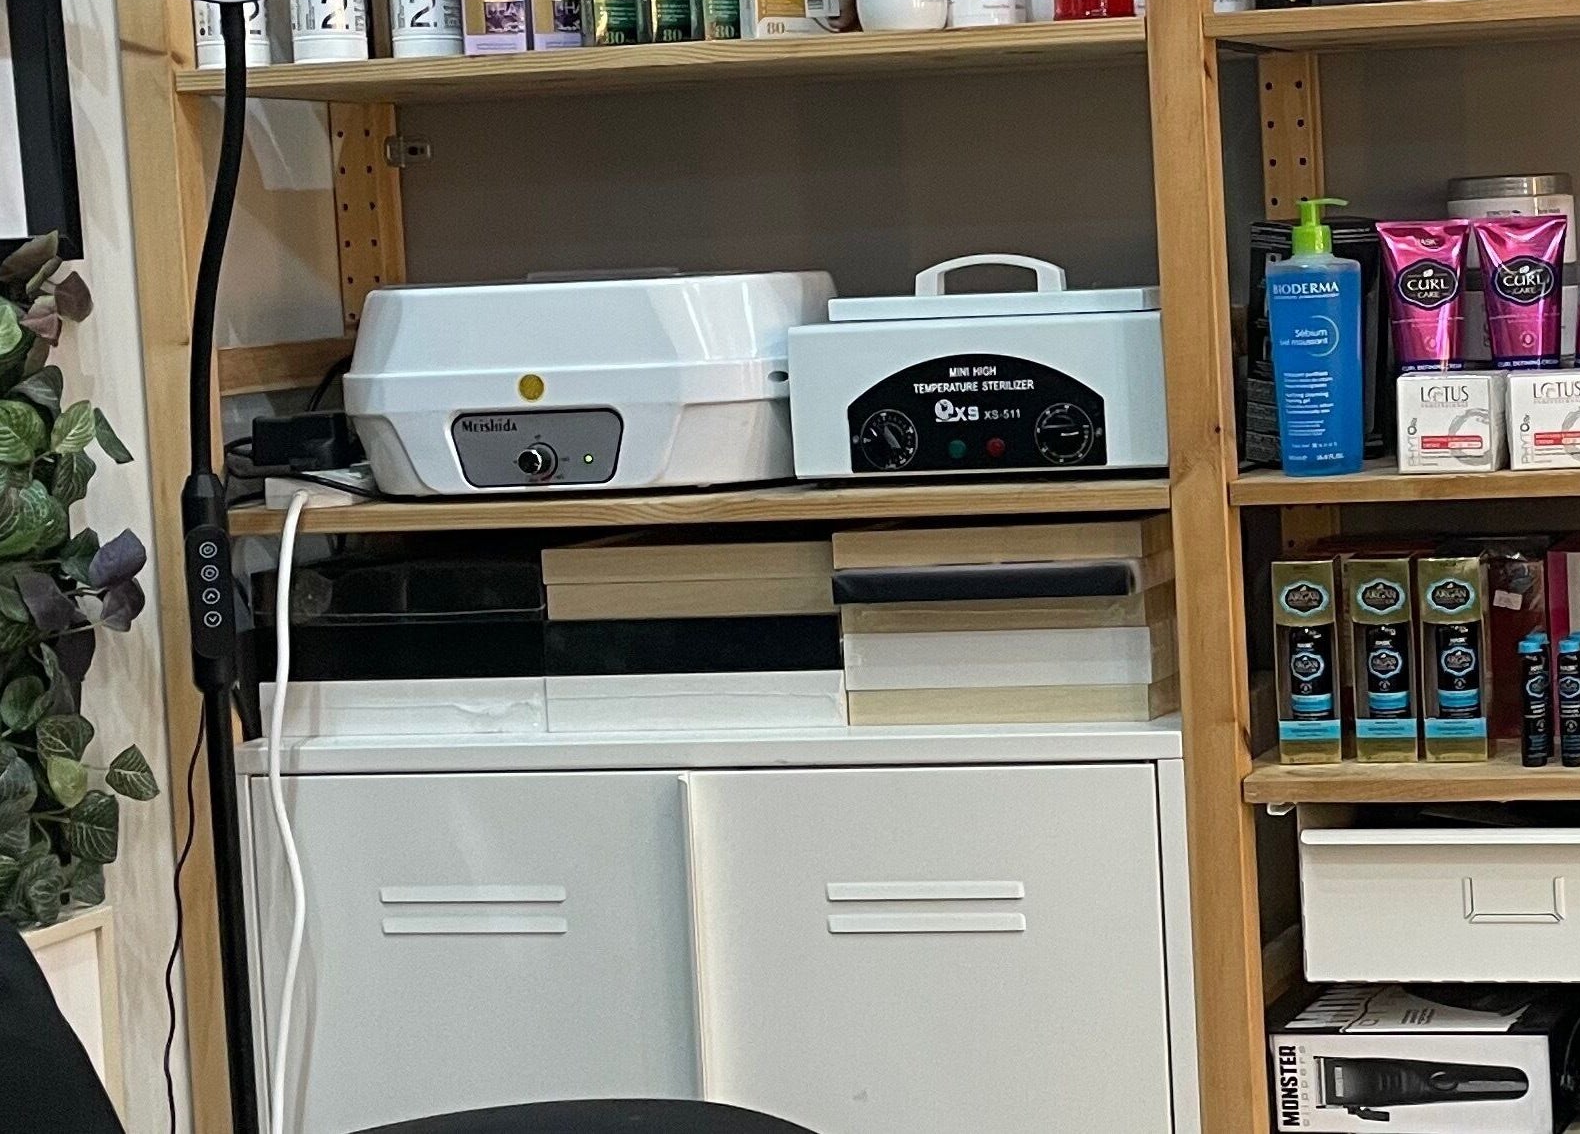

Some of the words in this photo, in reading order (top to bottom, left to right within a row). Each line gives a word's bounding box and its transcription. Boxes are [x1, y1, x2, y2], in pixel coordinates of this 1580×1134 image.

[766, 22, 785, 34] 80
[605, 31, 625, 44] 80
[662, 29, 683, 42] 80
[1406, 278, 1450, 292] CURL
[1503, 273, 1545, 287] CURL
[1273, 282, 1339, 296] BIODERMA
[1417, 291, 1441, 299] CARE
[949, 367, 970, 377] MINI
[972, 366, 997, 377] HIGH
[914, 382, 979, 394] TEMPERATURE
[981, 380, 1035, 391] STERILIZER
[1420, 385, 1469, 402] LOTUS
[1279, 1045, 1301, 1127] MONSTER
